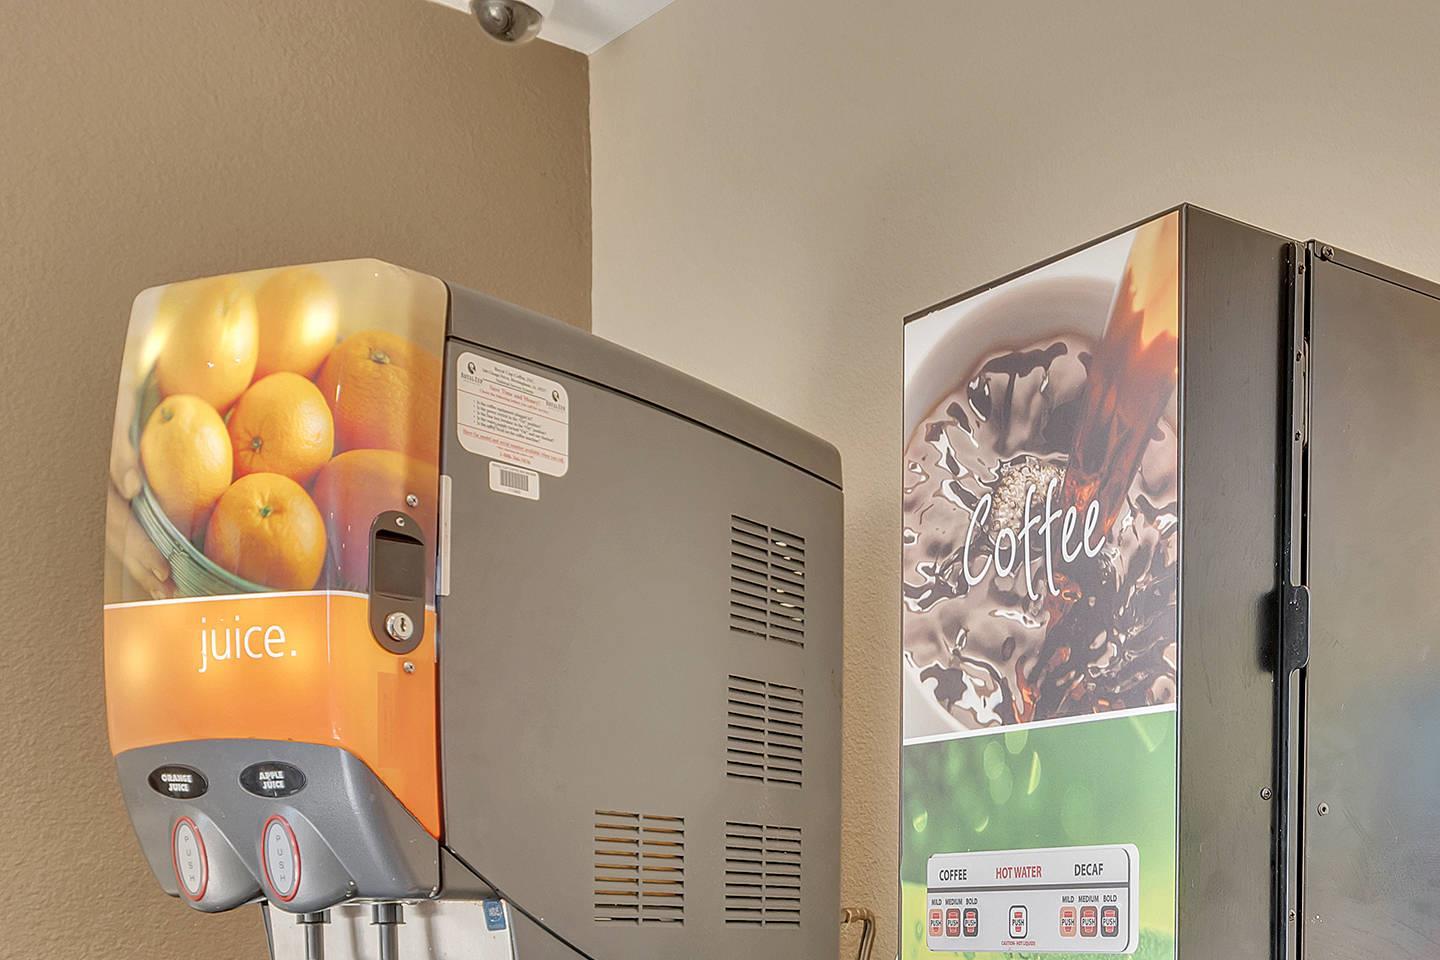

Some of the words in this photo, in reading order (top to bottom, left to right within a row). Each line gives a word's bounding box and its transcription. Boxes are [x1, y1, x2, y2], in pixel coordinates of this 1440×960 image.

[962, 476, 1106, 602] Coffee
[197, 614, 298, 673] juice.
[160, 773, 193, 783] ORANGE
[258, 770, 285, 780] APPLE
[168, 783, 190, 792] JUICE
[262, 780, 286, 790] JUICE
[939, 868, 968, 881] COFFEE
[995, 867, 1013, 880] HOT
[1013, 865, 1042, 879] WATER
[1074, 863, 1104, 877] DECAF
[931, 898, 943, 906] MILD
[945, 898, 963, 906] MEDIUM
[965, 897, 978, 905] BOLD
[1061, 895, 1075, 903] MILD
[1078, 895, 1100, 903] MEDIUM
[1102, 894, 1118, 903] BOLD
[1012, 919, 1025, 927] PUSH
[1061, 918, 1075, 926] PUSH
[1082, 918, 1096, 926] PUSH
[1102, 918, 1117, 926] PUSH
